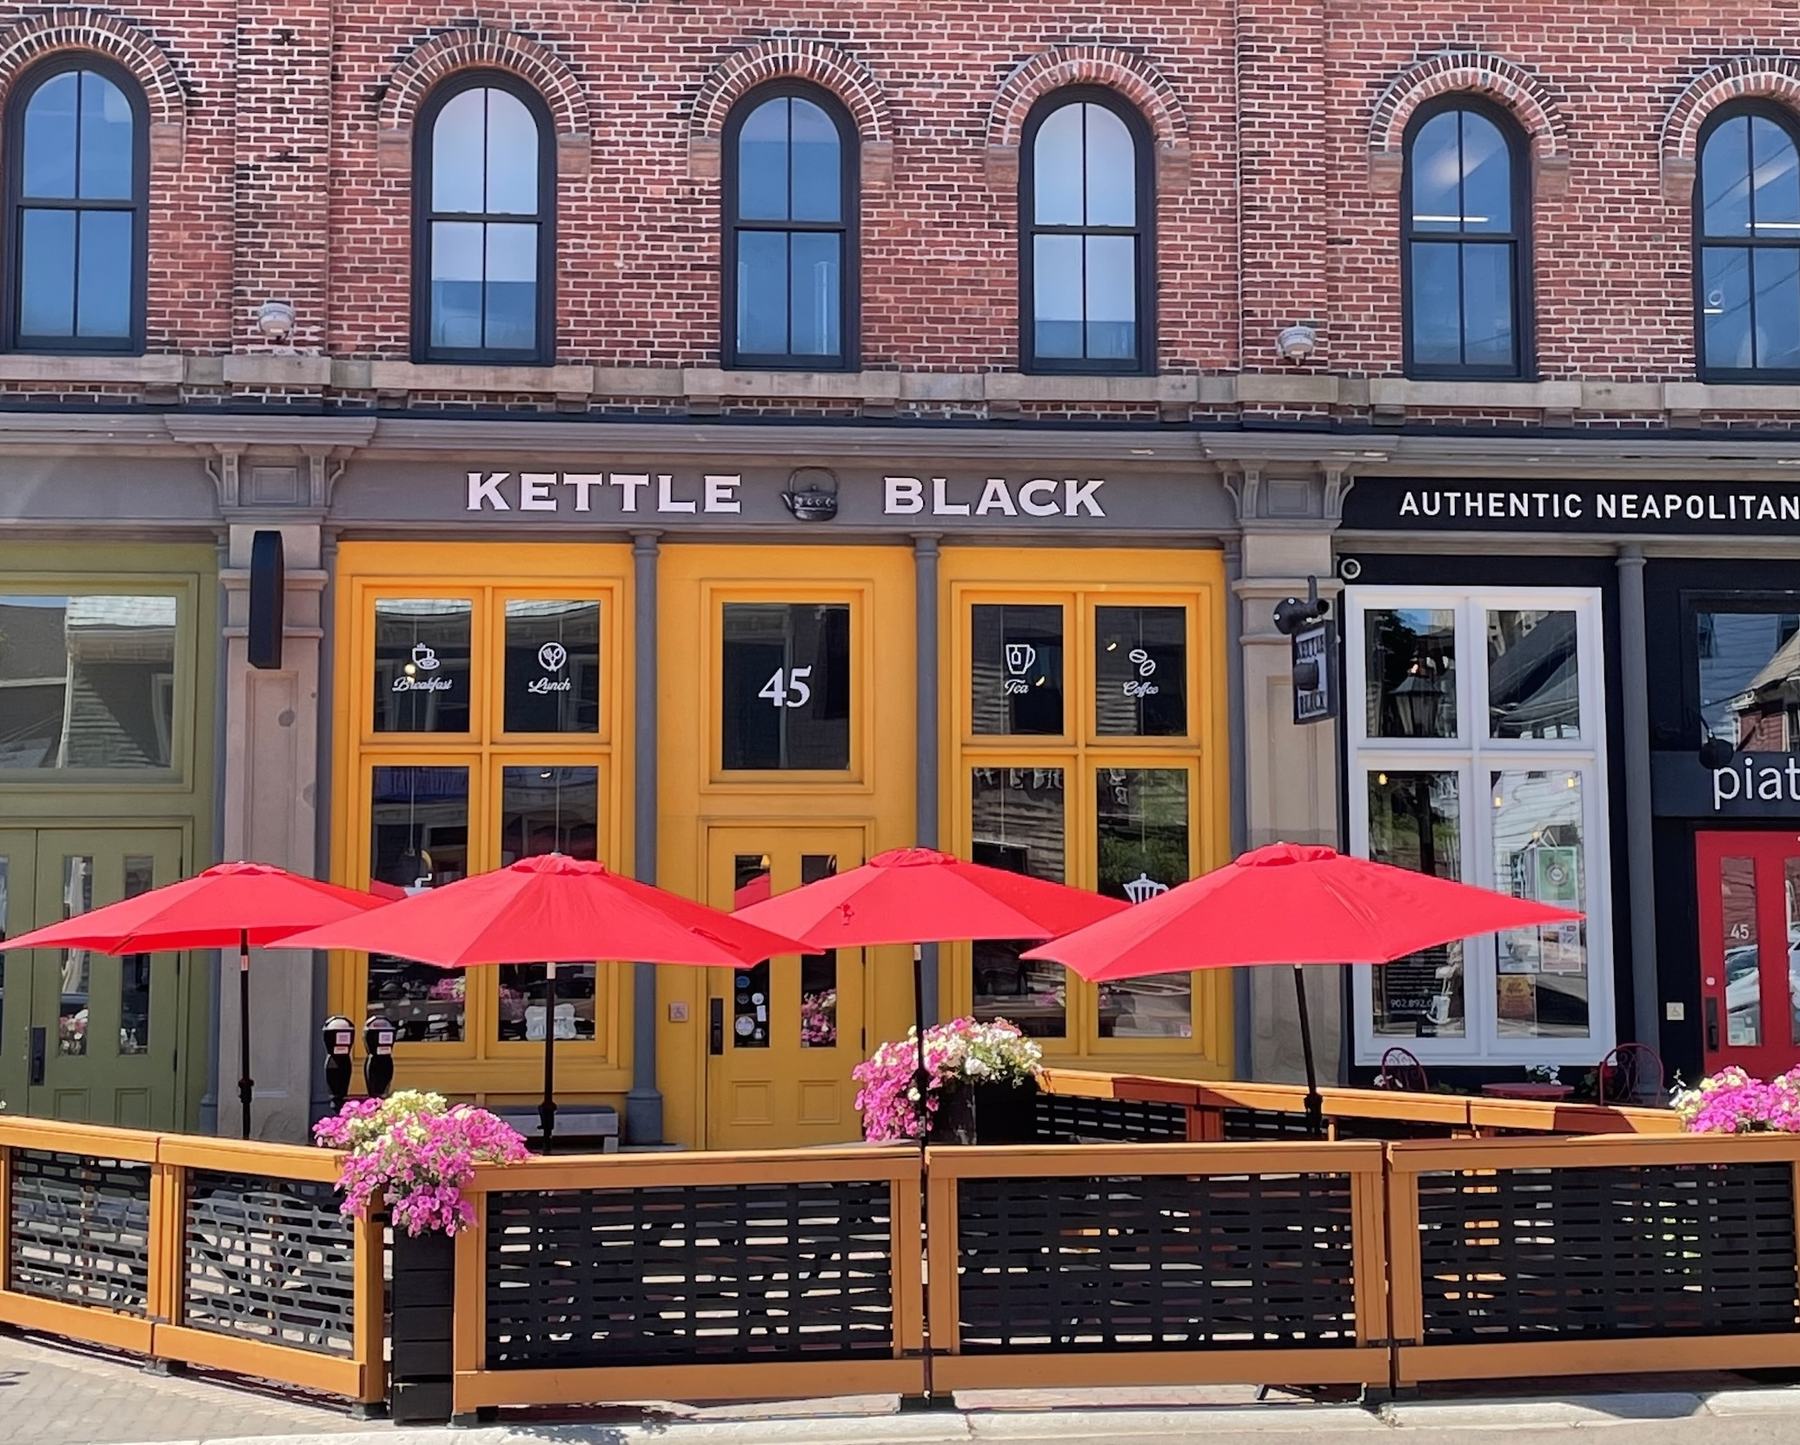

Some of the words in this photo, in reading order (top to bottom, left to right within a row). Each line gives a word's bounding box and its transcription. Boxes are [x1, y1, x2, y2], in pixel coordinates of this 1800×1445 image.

[467, 471, 742, 515] KETTLE
[883, 476, 1107, 518] BLACK
[1399, 491, 1582, 518] AUTHENTIC
[1597, 494, 1800, 520] NEAPOLITAN
[391, 675, 453, 693] Breakfast
[527, 676, 572, 694] Lunch
[758, 664, 812, 708] 45
[1004, 679, 1030, 696] Tea
[1122, 680, 1160, 698] Coffee
[1730, 923, 1750, 940] 45
[1390, 998, 1433, 1009] 902.892.0
